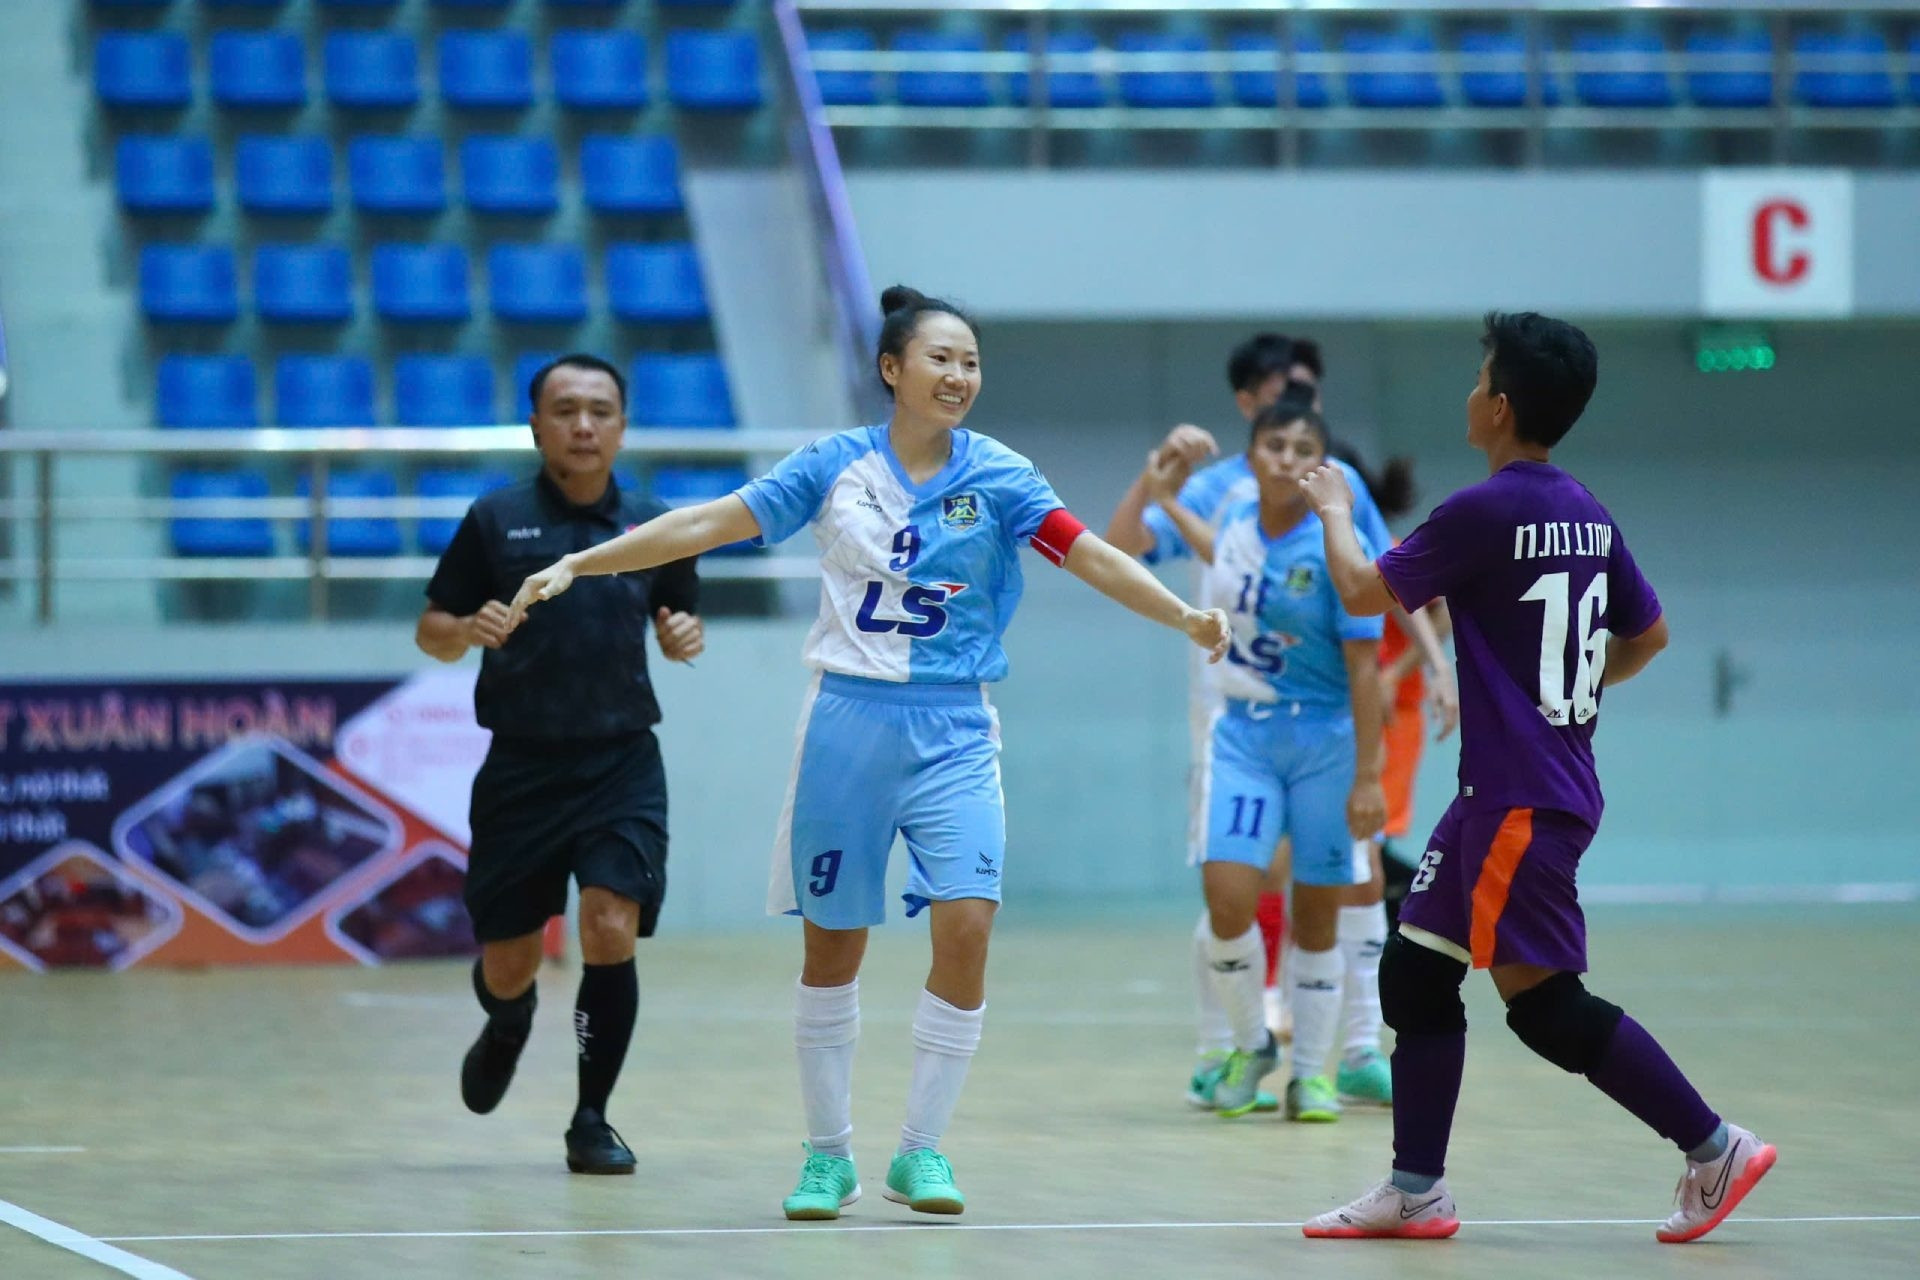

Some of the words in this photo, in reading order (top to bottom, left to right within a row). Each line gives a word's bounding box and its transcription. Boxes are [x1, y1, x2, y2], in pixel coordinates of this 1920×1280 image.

[1750, 199, 1810, 285] C
[889, 525, 920, 572] 9
[855, 580, 949, 638] LS
[1234, 573, 1273, 616] 11
[1517, 571, 1609, 726] 16
[23, 689, 171, 751] XUÂN
[178, 688, 338, 749] HOÀN
[1225, 793, 1266, 840] 11
[808, 849, 843, 898] 9
